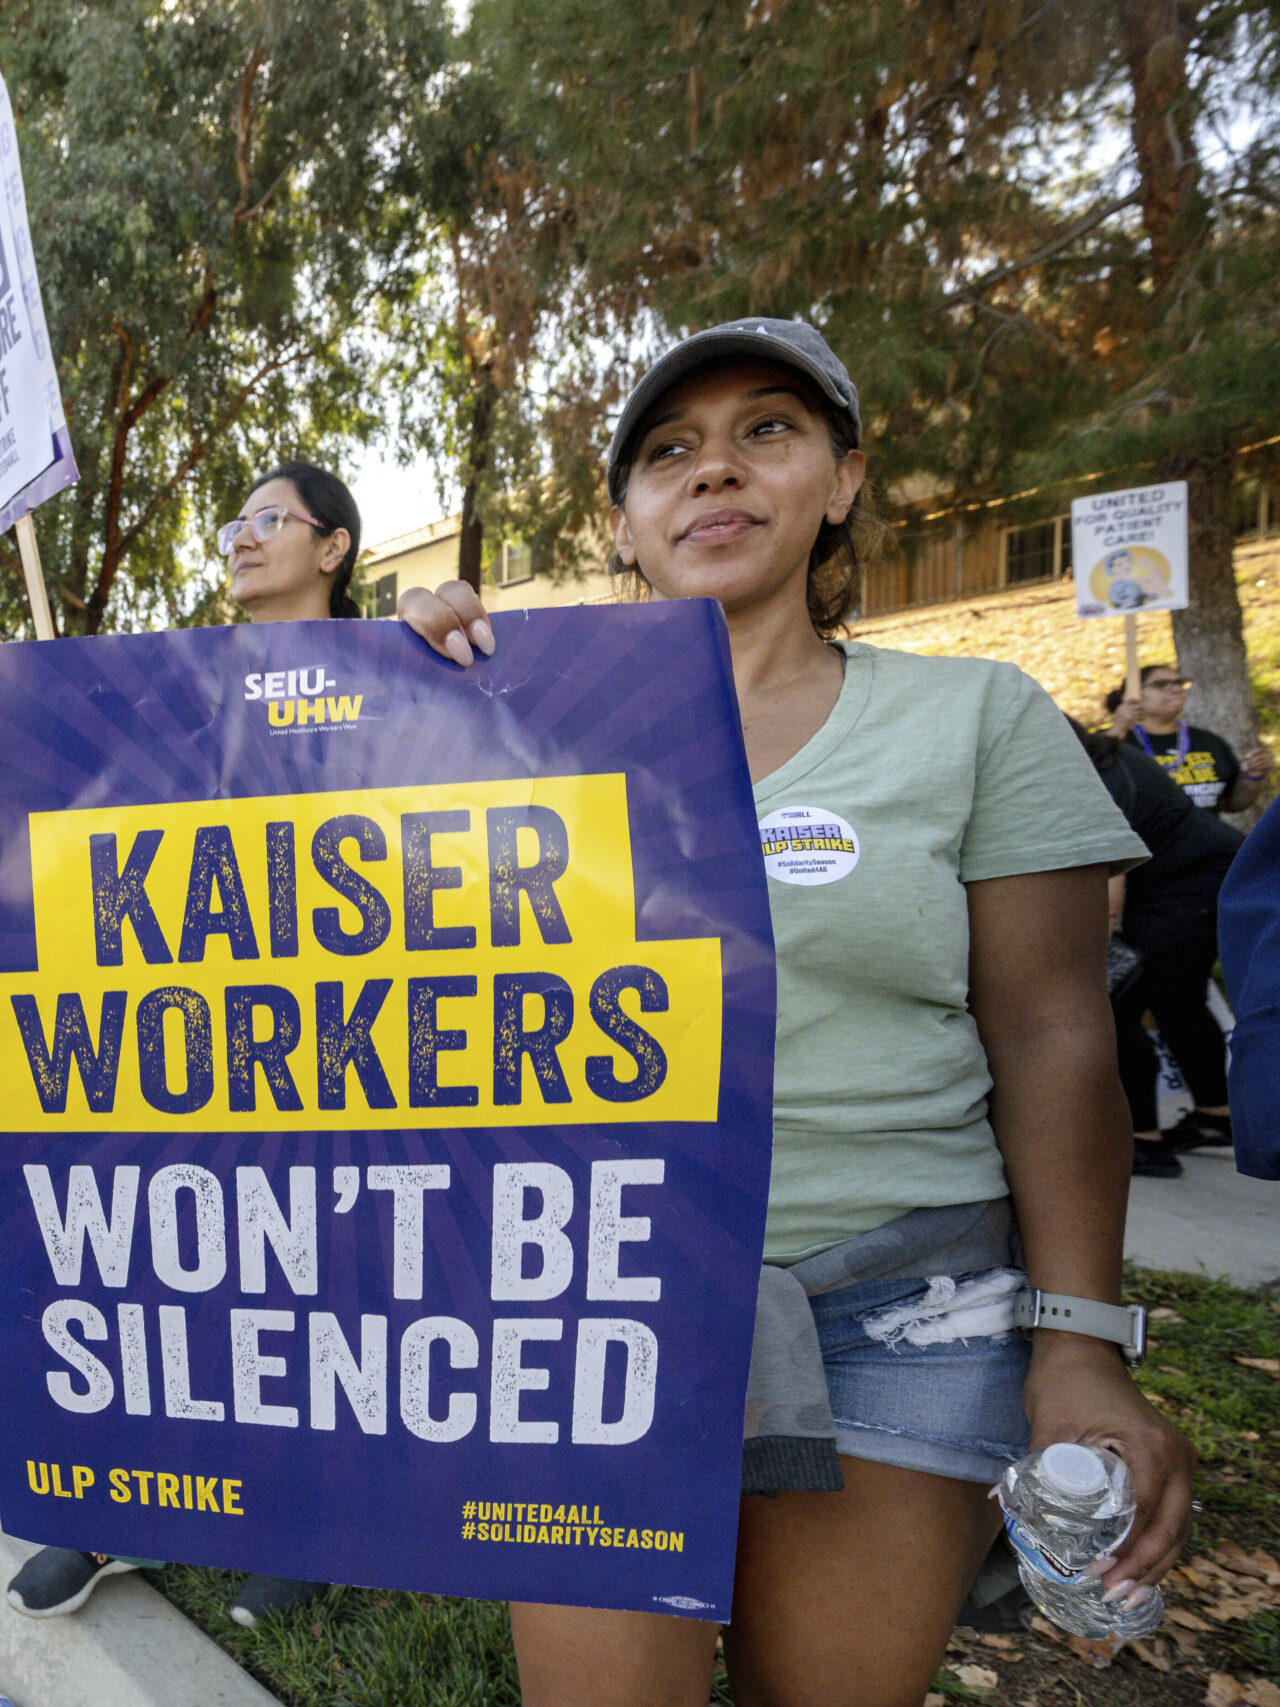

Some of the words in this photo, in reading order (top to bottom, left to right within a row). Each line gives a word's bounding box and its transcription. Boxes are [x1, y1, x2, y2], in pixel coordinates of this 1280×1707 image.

[1091, 488, 1166, 511] UNITED
[1094, 515, 1163, 536] PATIENT
[243, 667, 337, 701] SEIU-
[267, 693, 365, 728] UHW
[760, 823, 843, 844] KAISER
[790, 837, 856, 854] STRIKE
[88, 804, 575, 969] KAISER
[10, 963, 672, 1116] WORKERS
[22, 1161, 452, 1302] WON'T
[490, 1157, 666, 1303] BE
[40, 1297, 661, 1446] SILENCED
[26, 1459, 96, 1501] ULP
[109, 1467, 245, 1517] STRIKE
[461, 1500, 605, 1526] #UNITED4ALL
[460, 1521, 685, 1553] #SOLIDARITYSEASON
